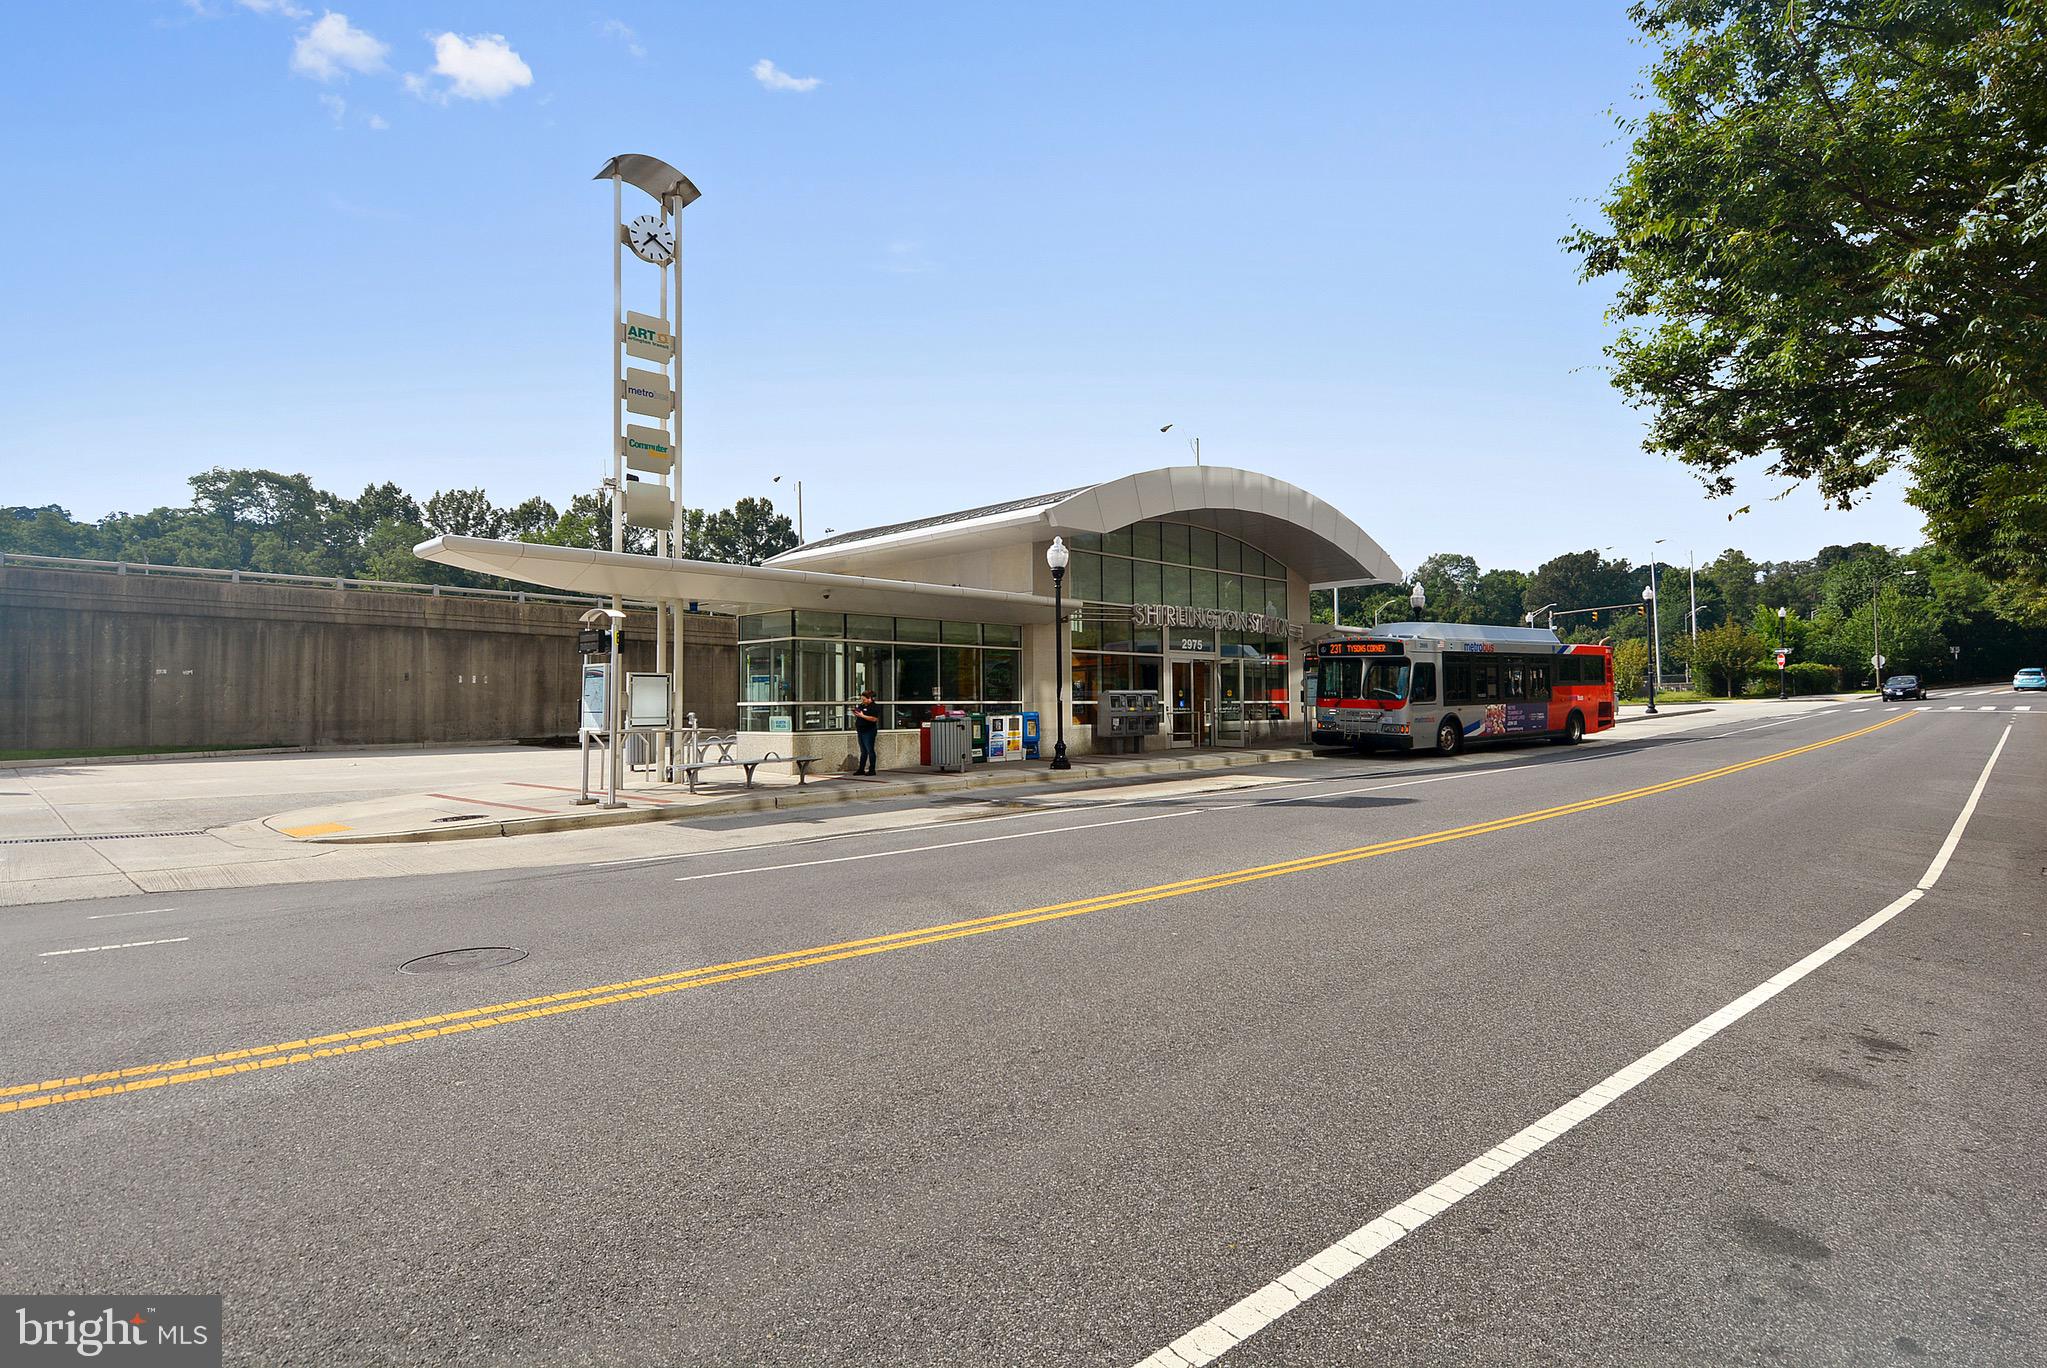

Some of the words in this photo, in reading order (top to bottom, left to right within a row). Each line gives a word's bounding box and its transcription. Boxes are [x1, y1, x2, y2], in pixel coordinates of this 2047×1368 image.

[628, 325, 656, 341] ART
[629, 438, 668, 453] Commuter
[1134, 603, 1248, 631] SHIRLINGTON
[1249, 612, 1290, 638] STATION
[1181, 639, 1203, 650] 2975
[1330, 643, 1342, 654] 23T
[1347, 644, 1366, 653] TYSONS
[1366, 644, 1386, 653] CORNER
[1463, 641, 1496, 653] metrobus
